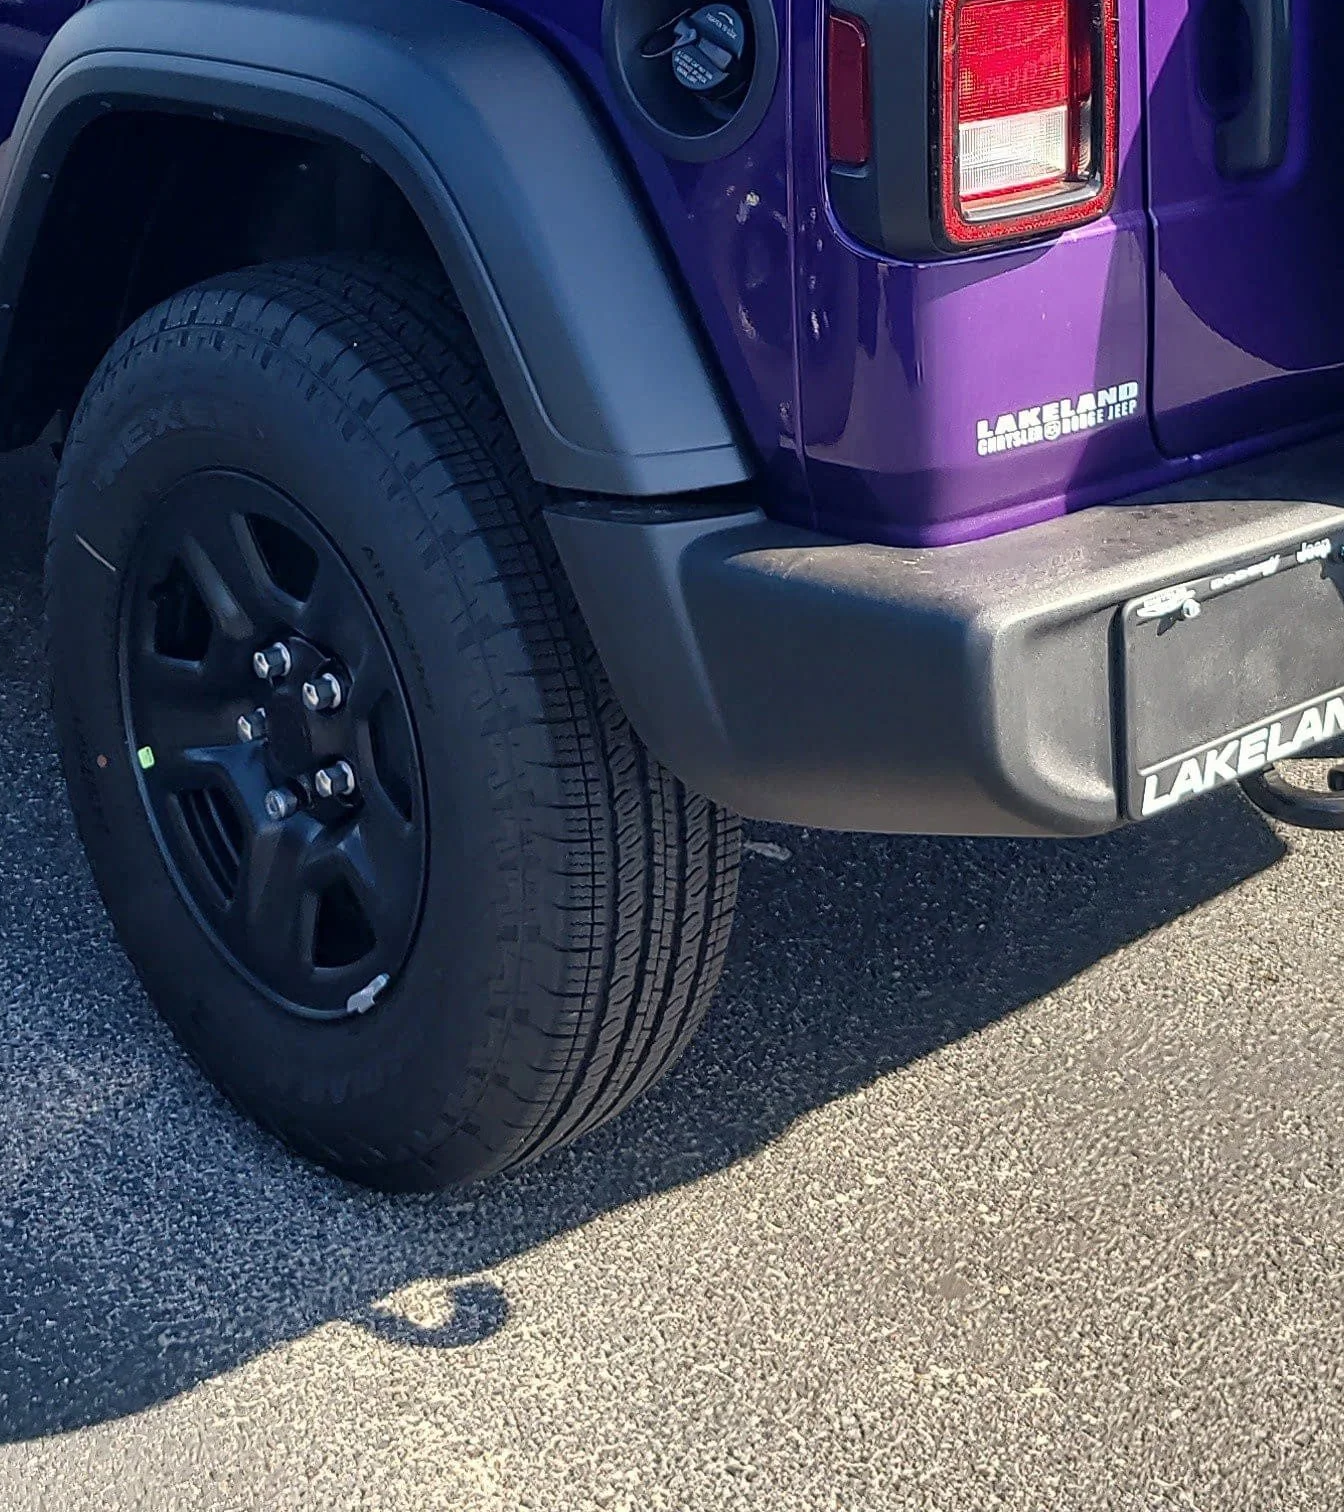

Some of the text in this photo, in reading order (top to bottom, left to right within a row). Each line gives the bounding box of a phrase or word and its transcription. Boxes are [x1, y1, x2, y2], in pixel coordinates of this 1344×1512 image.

[976, 381, 1138, 439] LAKELAND
[976, 399, 1138, 456] CHRYSLER DODGE JEEP
[1296, 538, 1331, 563] Jeep
